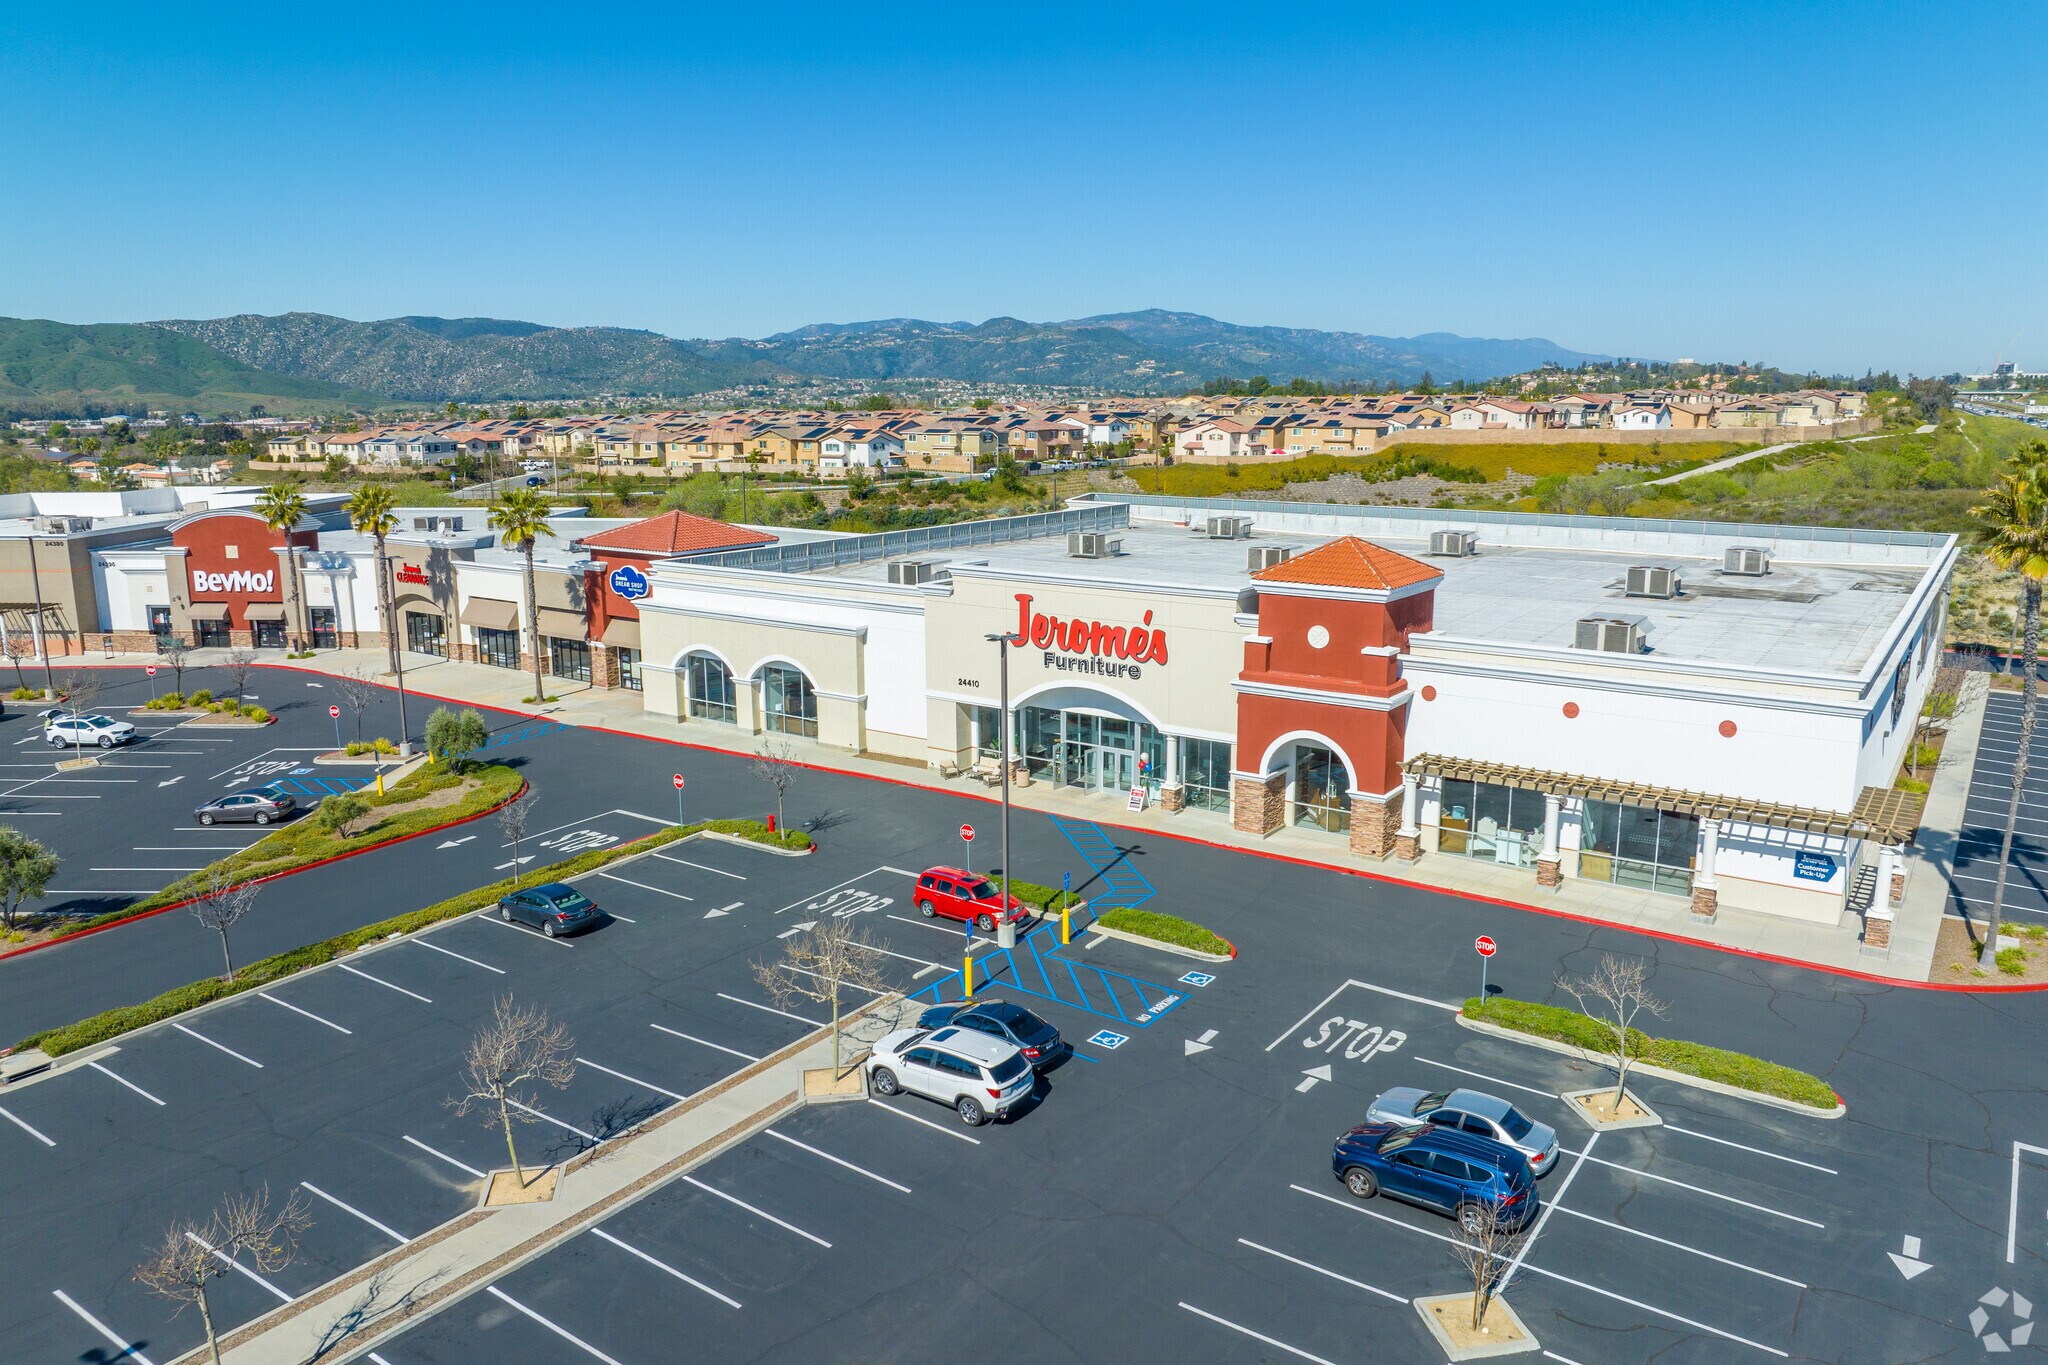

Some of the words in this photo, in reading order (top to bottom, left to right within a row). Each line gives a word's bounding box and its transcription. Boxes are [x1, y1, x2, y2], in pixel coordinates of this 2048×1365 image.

[193, 569, 275, 593] BevMo!
[1006, 593, 1169, 666] Jerome's
[1043, 651, 1142, 680] Furniture
[958, 677, 980, 688] 24410
[234, 761, 301, 776] STOP
[539, 829, 620, 853] STOP
[1798, 863, 1829, 873] Customer
[1800, 870, 1826, 879] Pick-Up
[806, 888, 895, 919] STOP
[1477, 941, 1495, 951] STOP
[1136, 1013, 1152, 1022] NO
[1148, 995, 1179, 1013] PARKING
[1302, 1016, 1408, 1063] STOP
